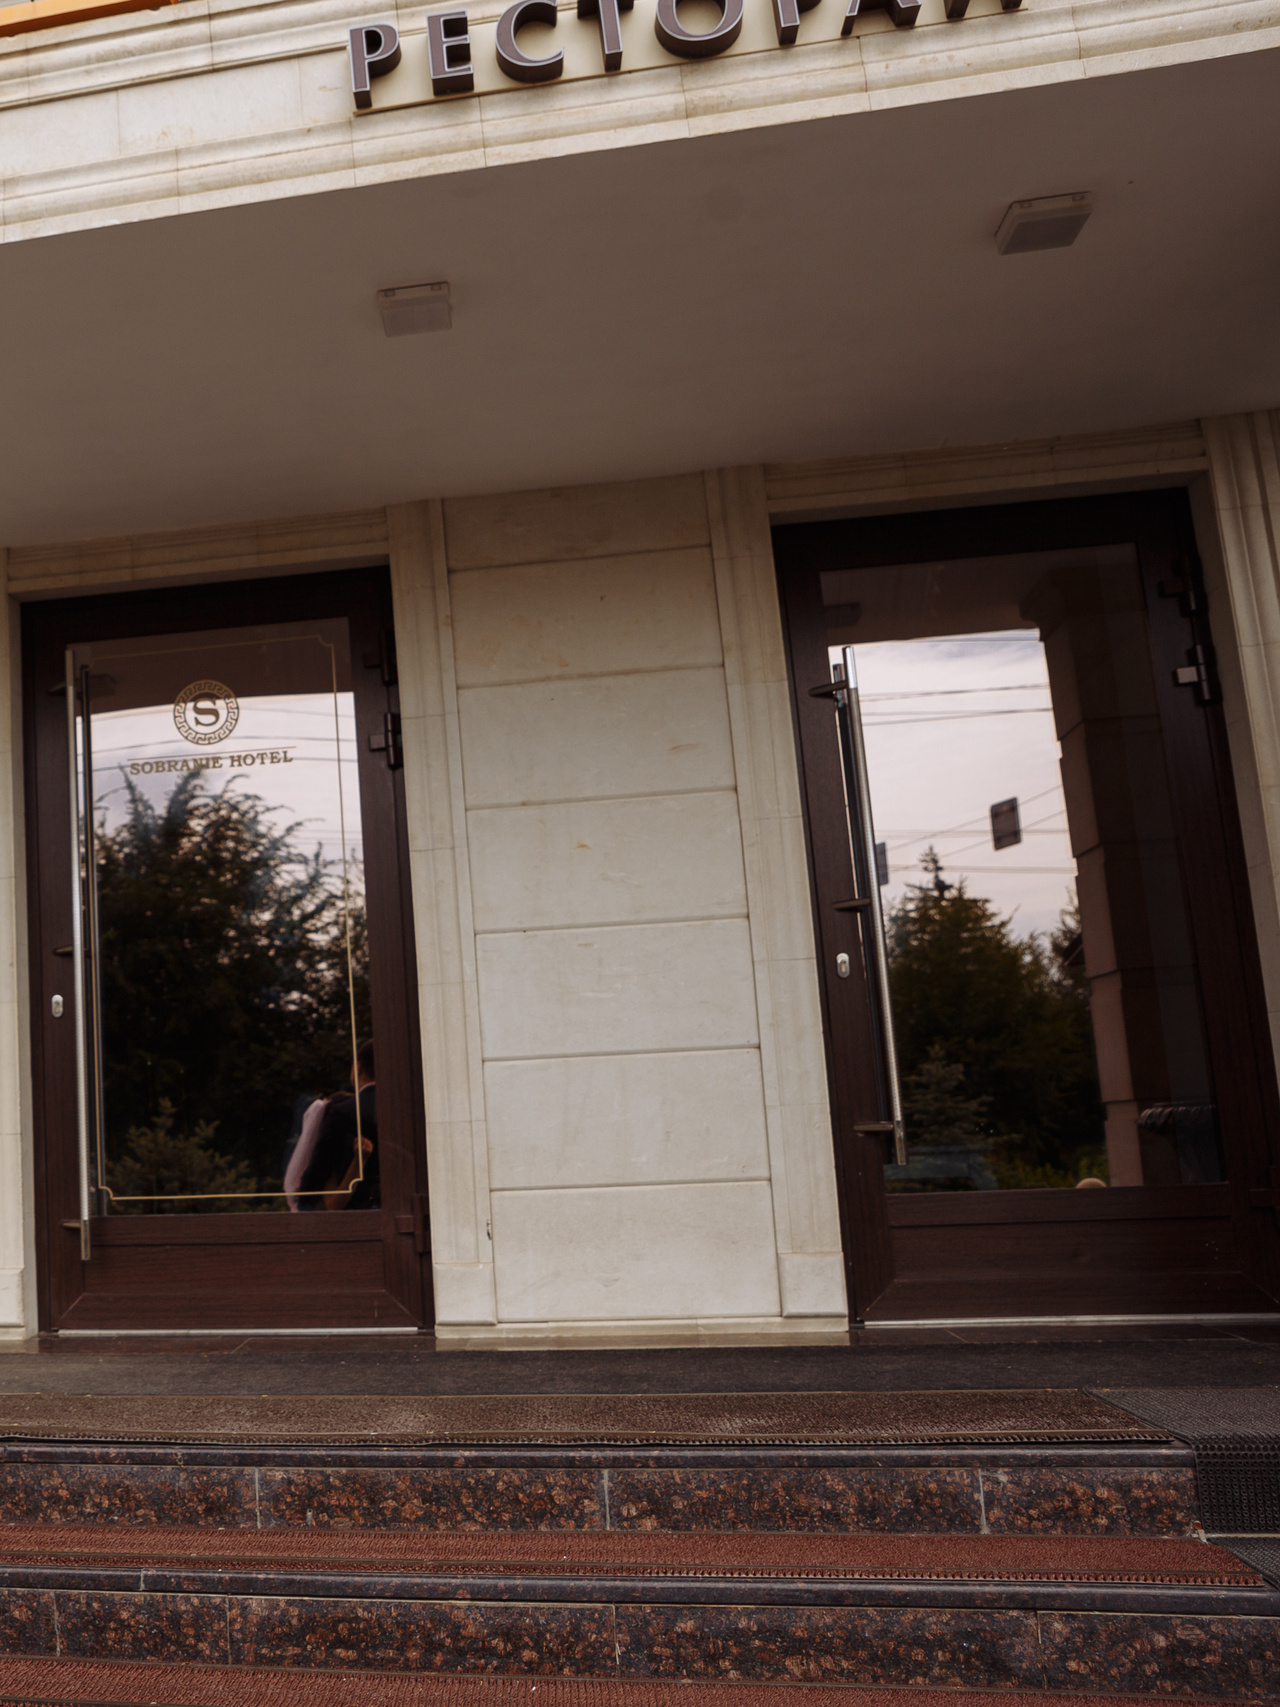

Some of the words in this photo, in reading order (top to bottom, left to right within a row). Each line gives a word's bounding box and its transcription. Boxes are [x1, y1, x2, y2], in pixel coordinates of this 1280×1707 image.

[193, 698, 219, 727] S
[129, 757, 223, 775] SOBRANIE
[229, 751, 293, 767] HOTEL
